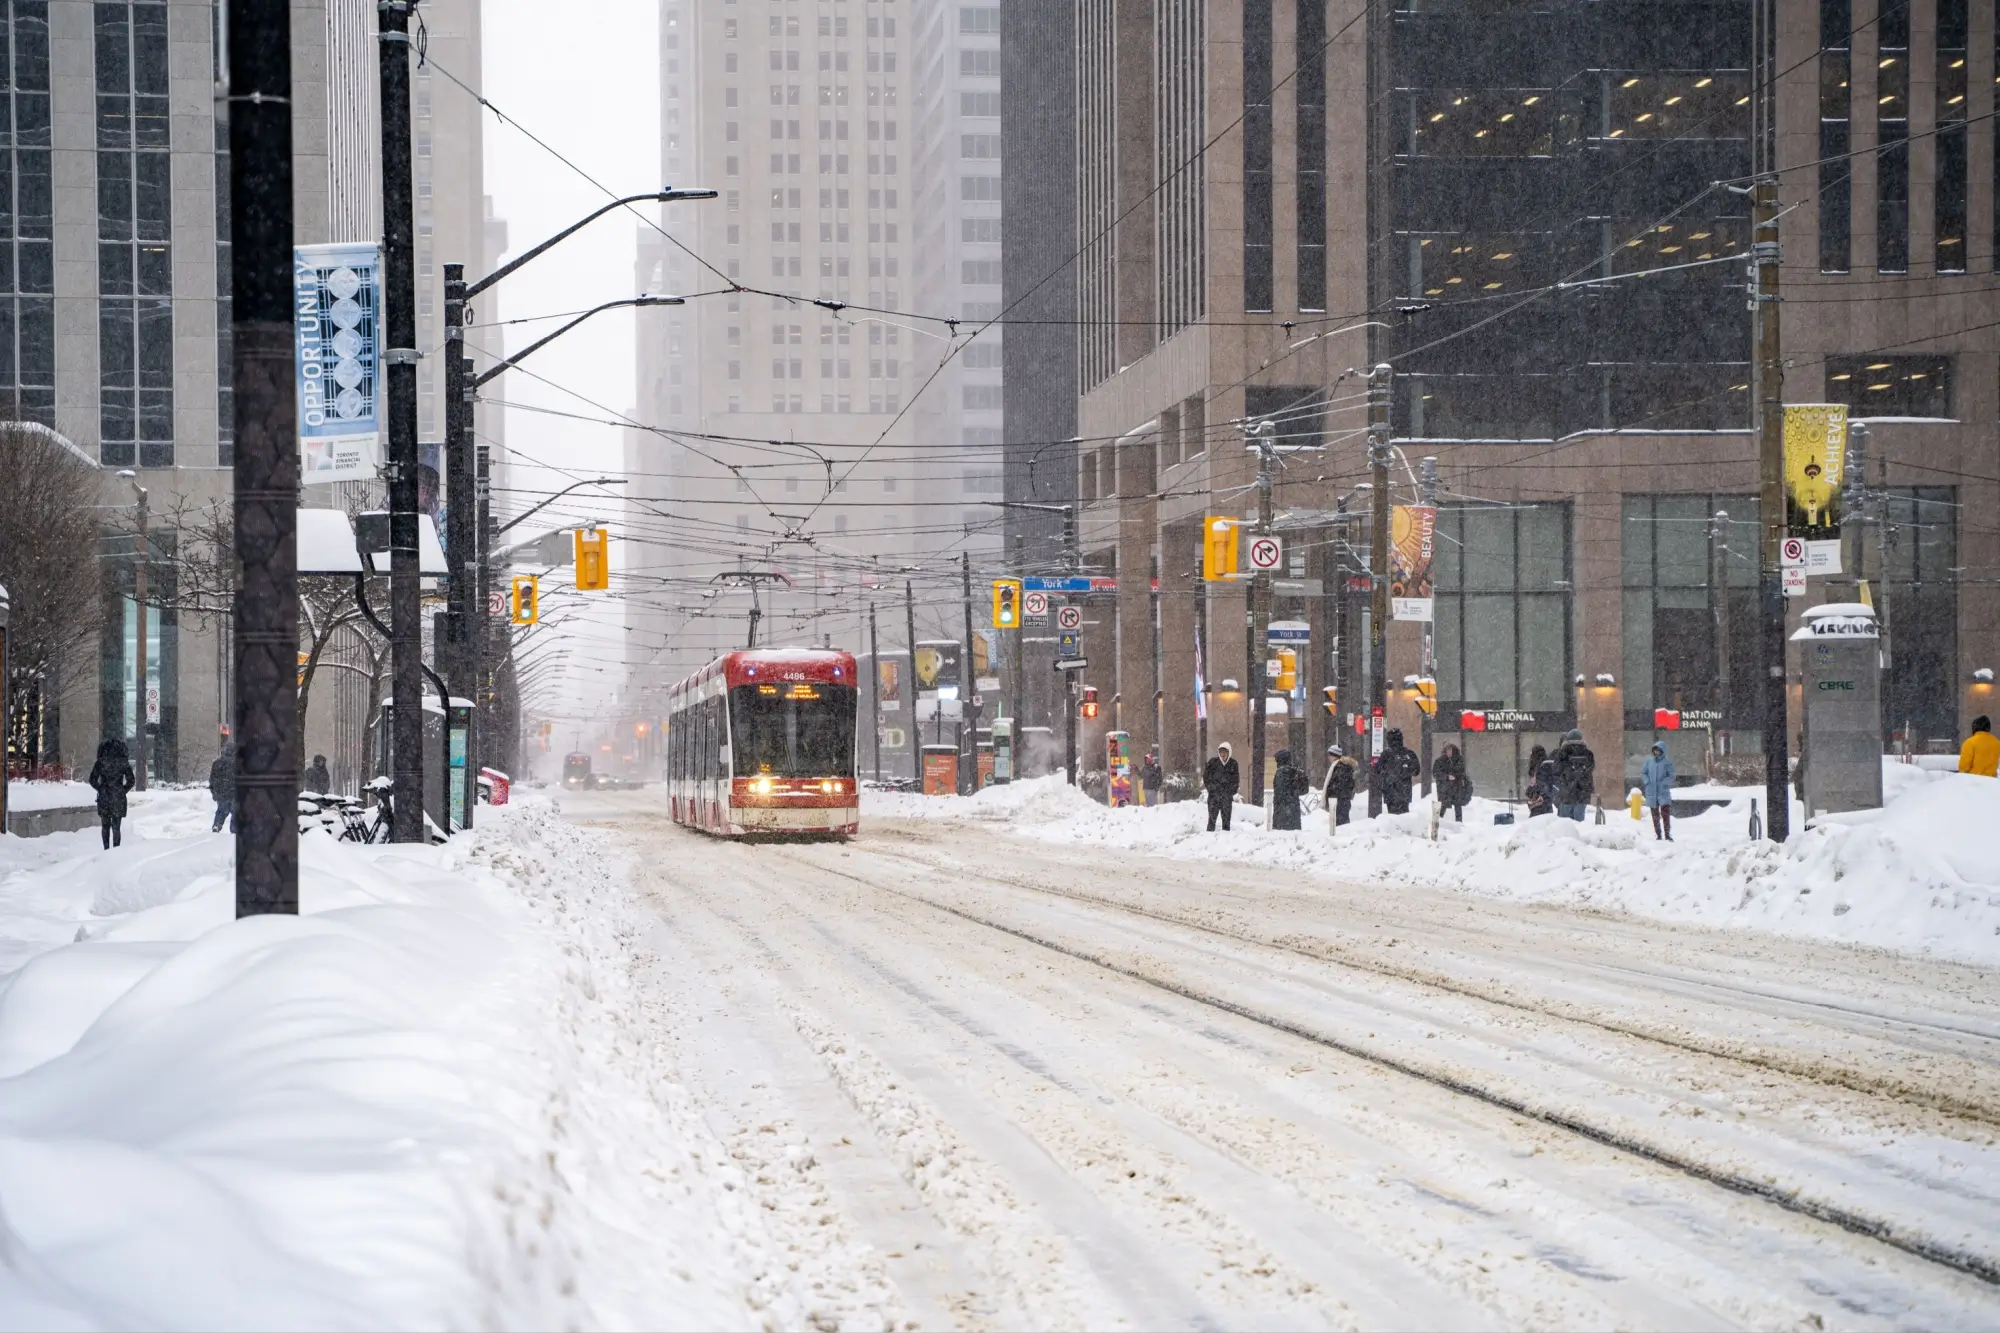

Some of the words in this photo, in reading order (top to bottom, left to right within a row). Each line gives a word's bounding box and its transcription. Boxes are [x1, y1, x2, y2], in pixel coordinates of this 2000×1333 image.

[296, 258, 326, 427] OPPORTUNITY
[1824, 412, 1844, 485] ACHIEVE
[1421, 512, 1433, 558] BEAUTY
[1041, 578, 1063, 588] York
[1784, 579, 1805, 587] STANDING
[1279, 630, 1294, 638] York
[783, 672, 805, 680] 4486
[1818, 680, 1855, 691] CBRE
[1487, 711, 1535, 721] NATIONAL
[1487, 722, 1514, 730] BANK
[1682, 720, 1709, 729] BANK
